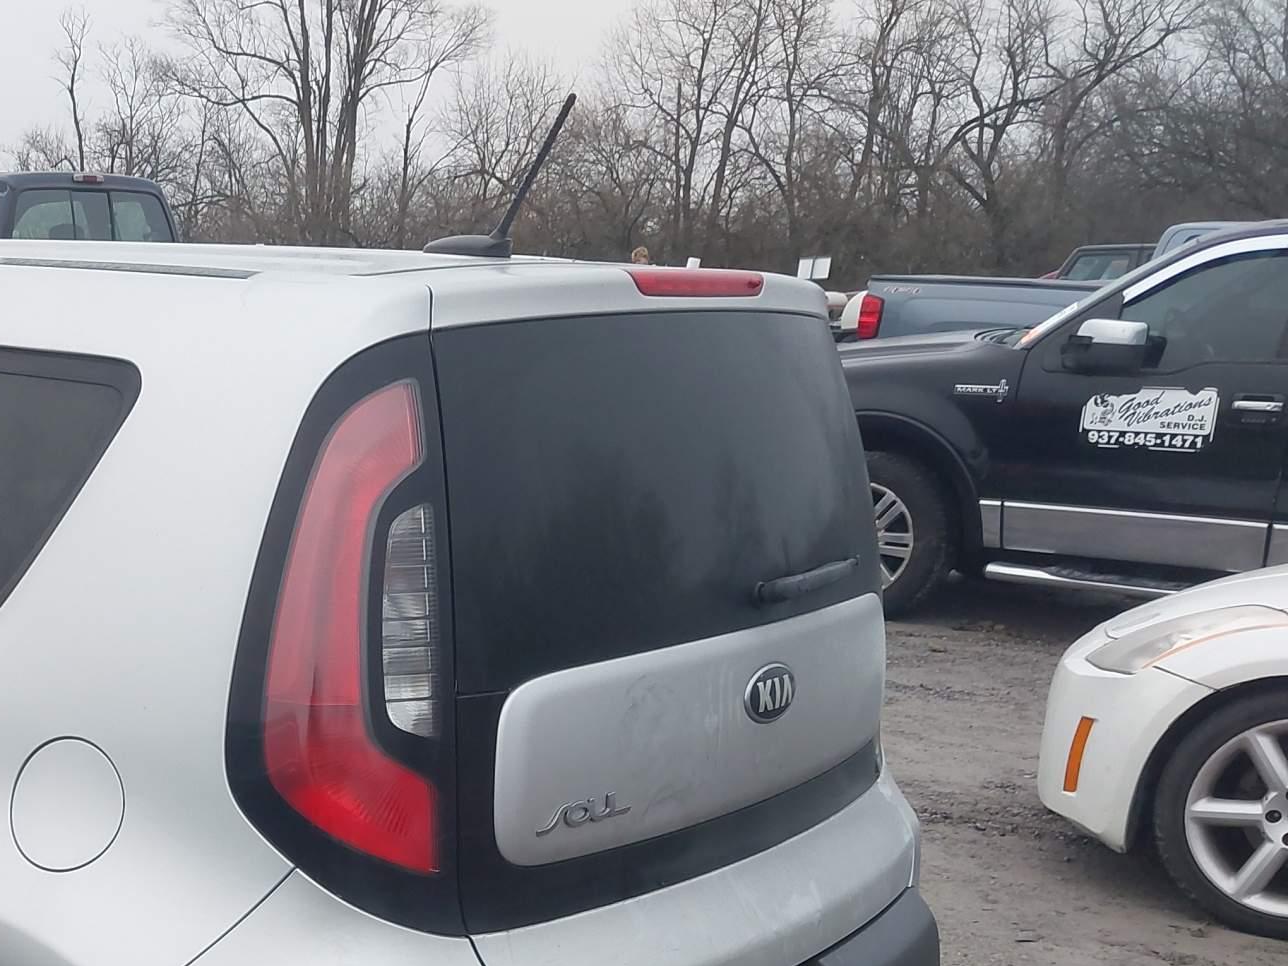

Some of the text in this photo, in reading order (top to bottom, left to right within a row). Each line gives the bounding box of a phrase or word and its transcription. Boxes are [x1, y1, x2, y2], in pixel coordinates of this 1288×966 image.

[1118, 391, 1165, 420] Good
[1123, 397, 1212, 427] Vibrations
[1160, 421, 1206, 431] SERVICE
[1187, 414, 1207, 422] D.J.
[1087, 431, 1203, 448] 937-845-1471
[757, 673, 792, 713] KIA
